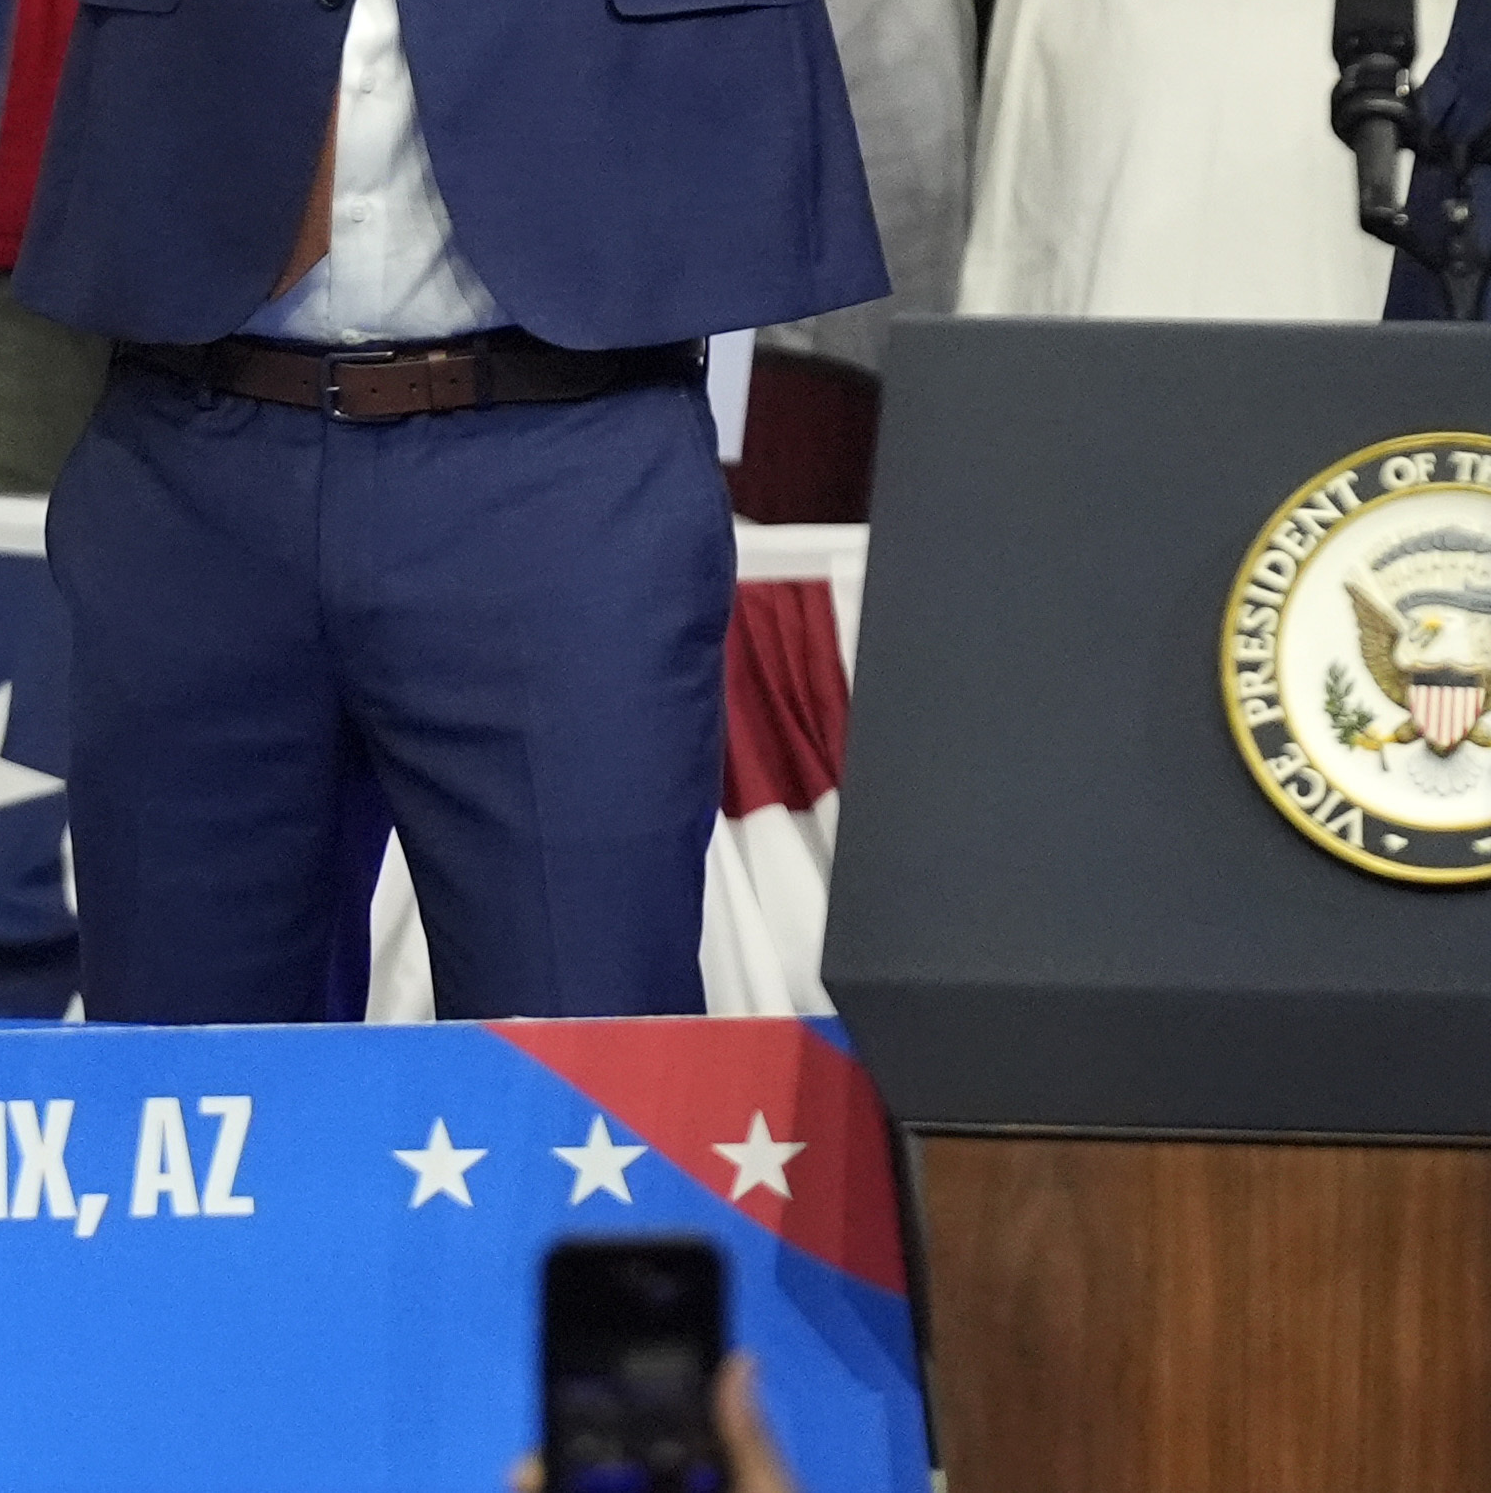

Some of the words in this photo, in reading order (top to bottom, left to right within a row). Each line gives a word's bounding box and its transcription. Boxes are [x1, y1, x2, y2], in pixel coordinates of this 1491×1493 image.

[1379, 451, 1438, 492] OF
[1231, 469, 1363, 727] PRESIDENT
[1267, 741, 1366, 850] VICE
[128, 1094, 255, 1219] AZ
